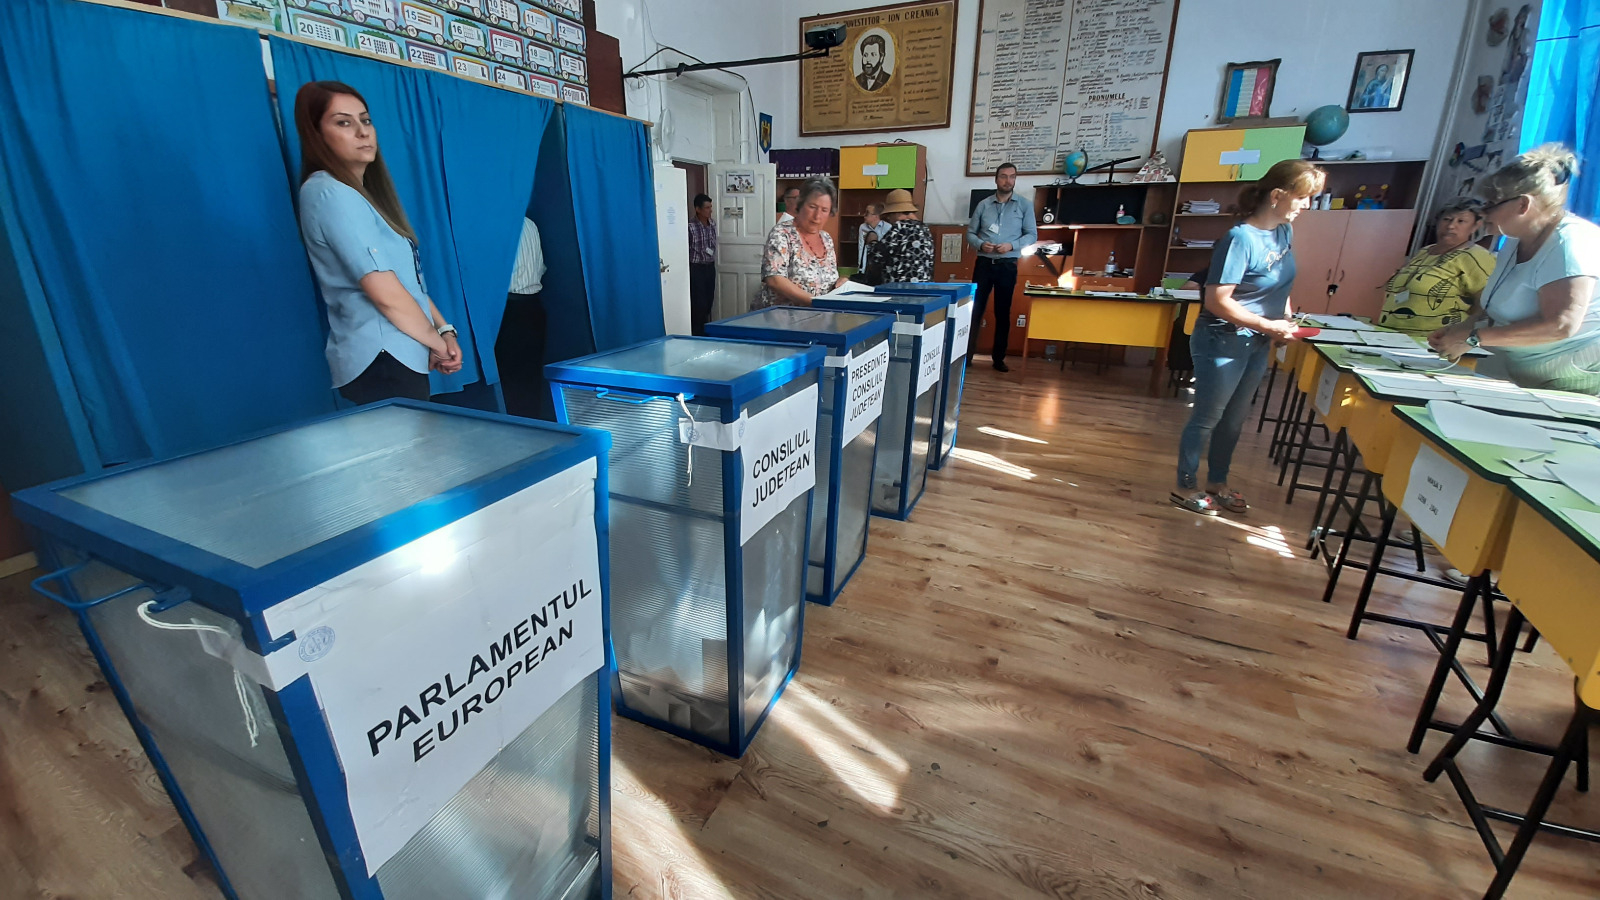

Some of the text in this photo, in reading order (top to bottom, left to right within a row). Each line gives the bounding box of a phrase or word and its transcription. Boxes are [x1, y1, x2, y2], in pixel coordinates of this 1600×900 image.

[405, 9, 417, 20] 15
[526, 14, 534, 23] 11
[888, 13, 901, 23] ION
[904, 7, 939, 21] CREANGA
[299, 22, 314, 35] 20
[452, 24, 463, 35] 16
[559, 25, 567, 34] 12
[359, 35, 371, 47] 21
[494, 37, 503, 47] 17
[410, 48, 422, 60] 22
[530, 48, 538, 57] 18
[457, 61, 467, 72] 23
[562, 57, 570, 66] 19
[497, 71, 506, 81] 24
[533, 80, 541, 89] 25
[564, 88, 571, 97] 26
[1088, 92, 1126, 102] PRONUMELE
[923, 345, 941, 364] CONSILIUL
[851, 351, 887, 384] PRESEDINTE
[852, 372, 883, 402] CONSILIUL
[850, 388, 882, 422] JUDETEAN
[752, 428, 811, 479] CONSILIUL
[752, 451, 811, 508] JUDETEAN
[366, 579, 592, 757] PARLAMENTUL
[413, 619, 573, 762] EUROPEAN
